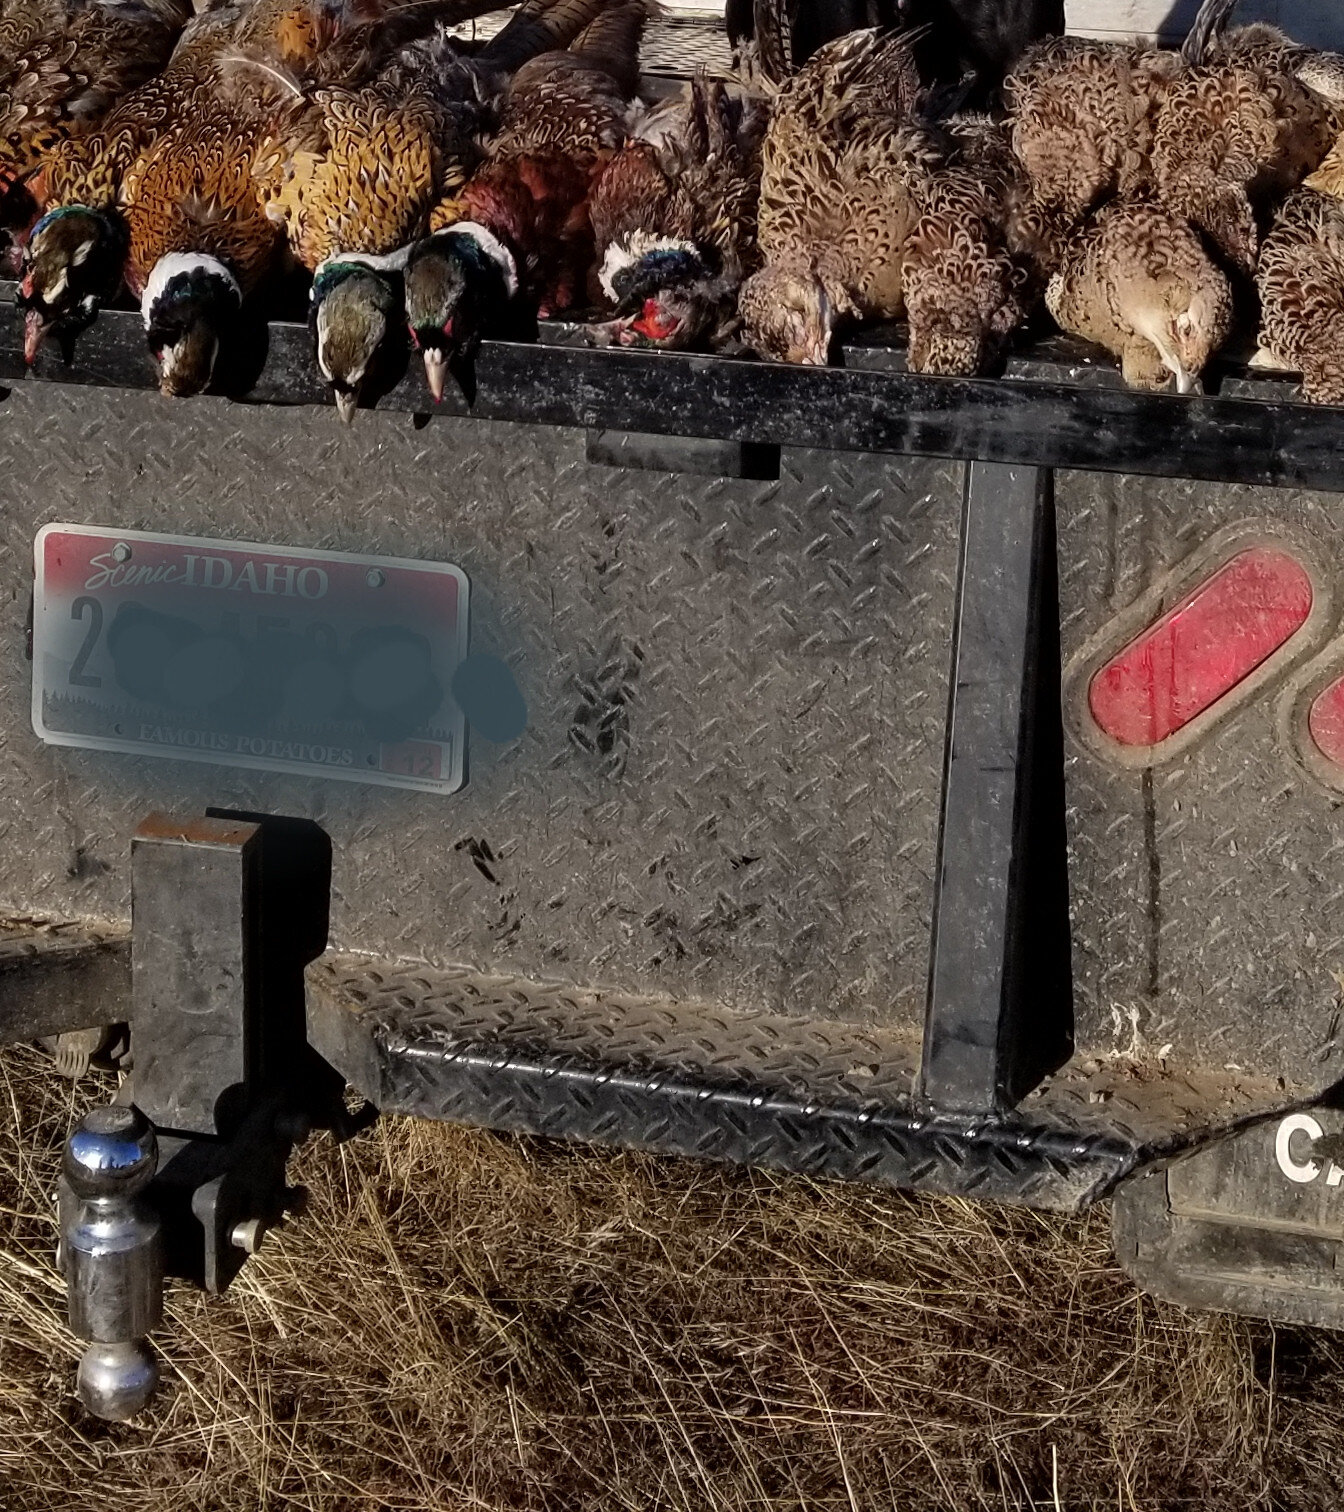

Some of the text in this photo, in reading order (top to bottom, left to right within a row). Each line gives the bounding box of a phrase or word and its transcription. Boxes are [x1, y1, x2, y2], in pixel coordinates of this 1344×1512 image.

[85, 550, 329, 600] Scenic IDAHO
[138, 724, 354, 766] FAMOUS POTATOES
